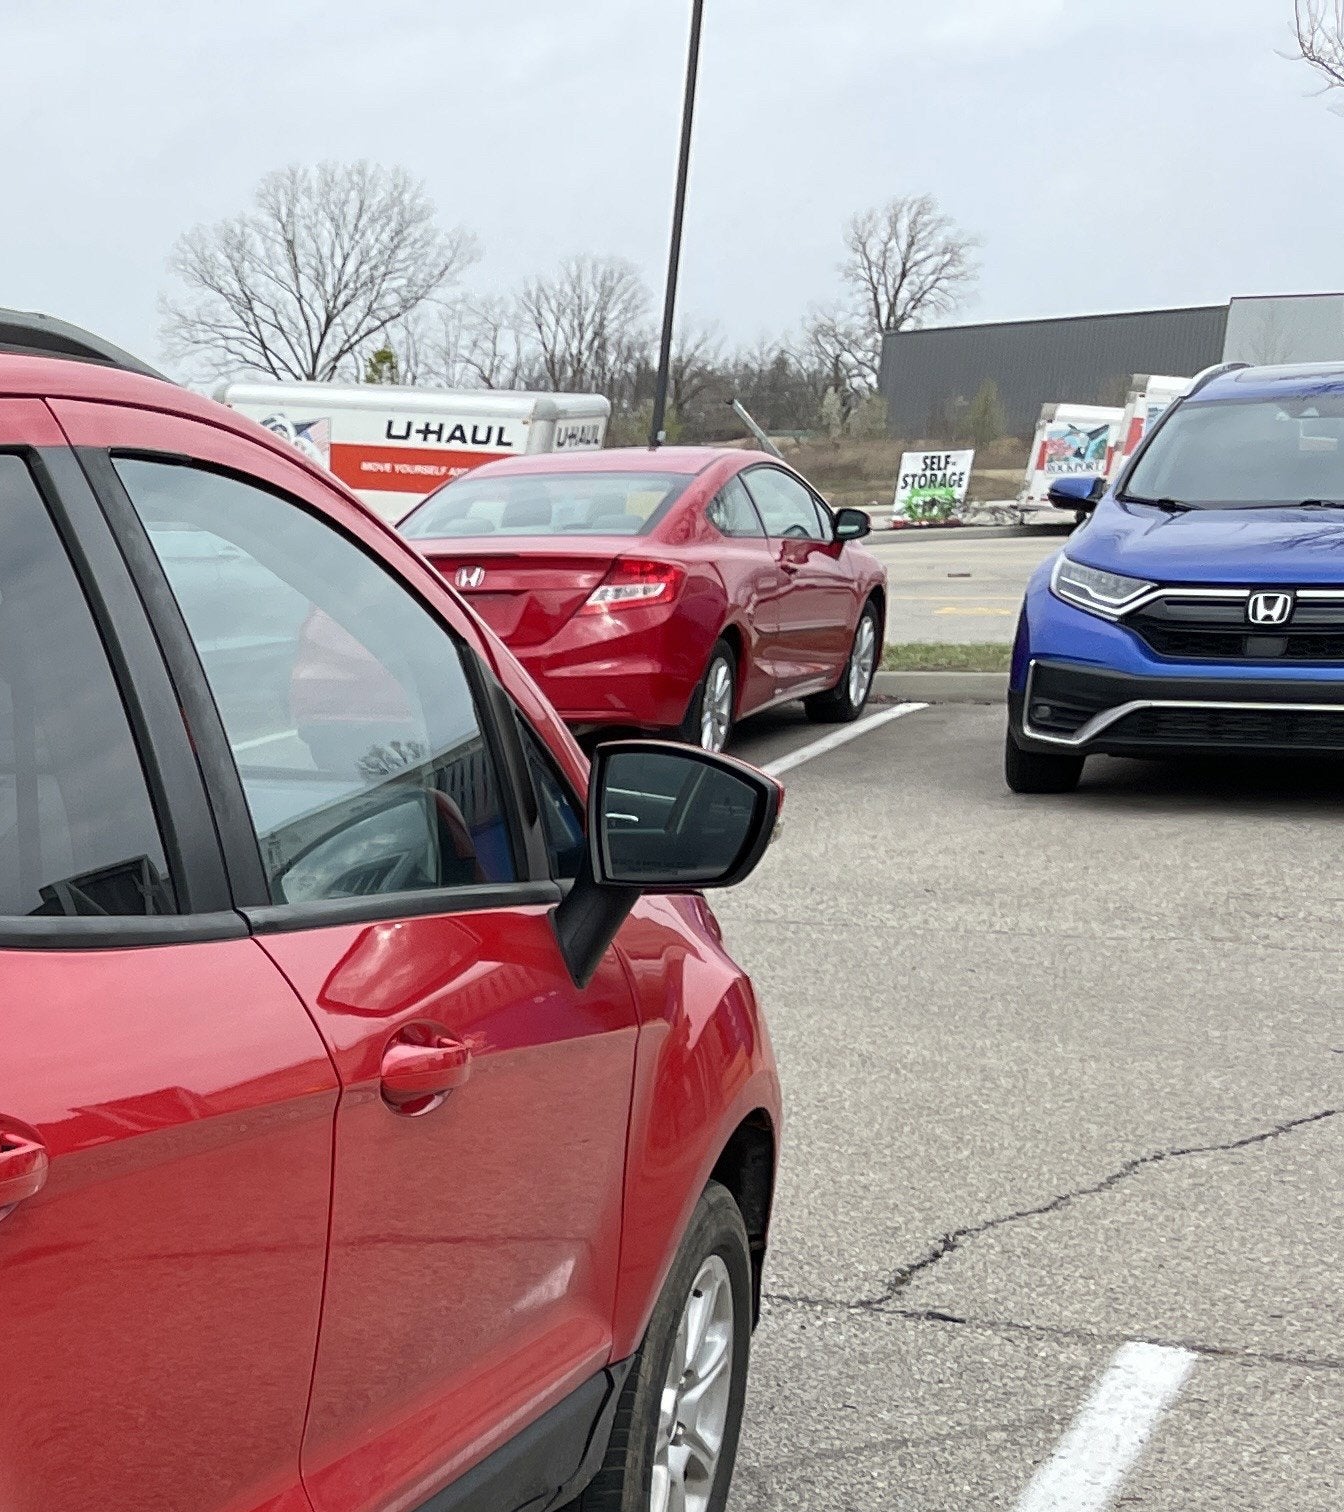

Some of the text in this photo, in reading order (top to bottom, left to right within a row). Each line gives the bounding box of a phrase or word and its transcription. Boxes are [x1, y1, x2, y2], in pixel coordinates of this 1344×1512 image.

[385, 419, 513, 447] U-HAUL
[360, 461, 393, 474] MOVE
[394, 463, 448, 477] YOURSELF
[900, 471, 966, 490] STORAGE
